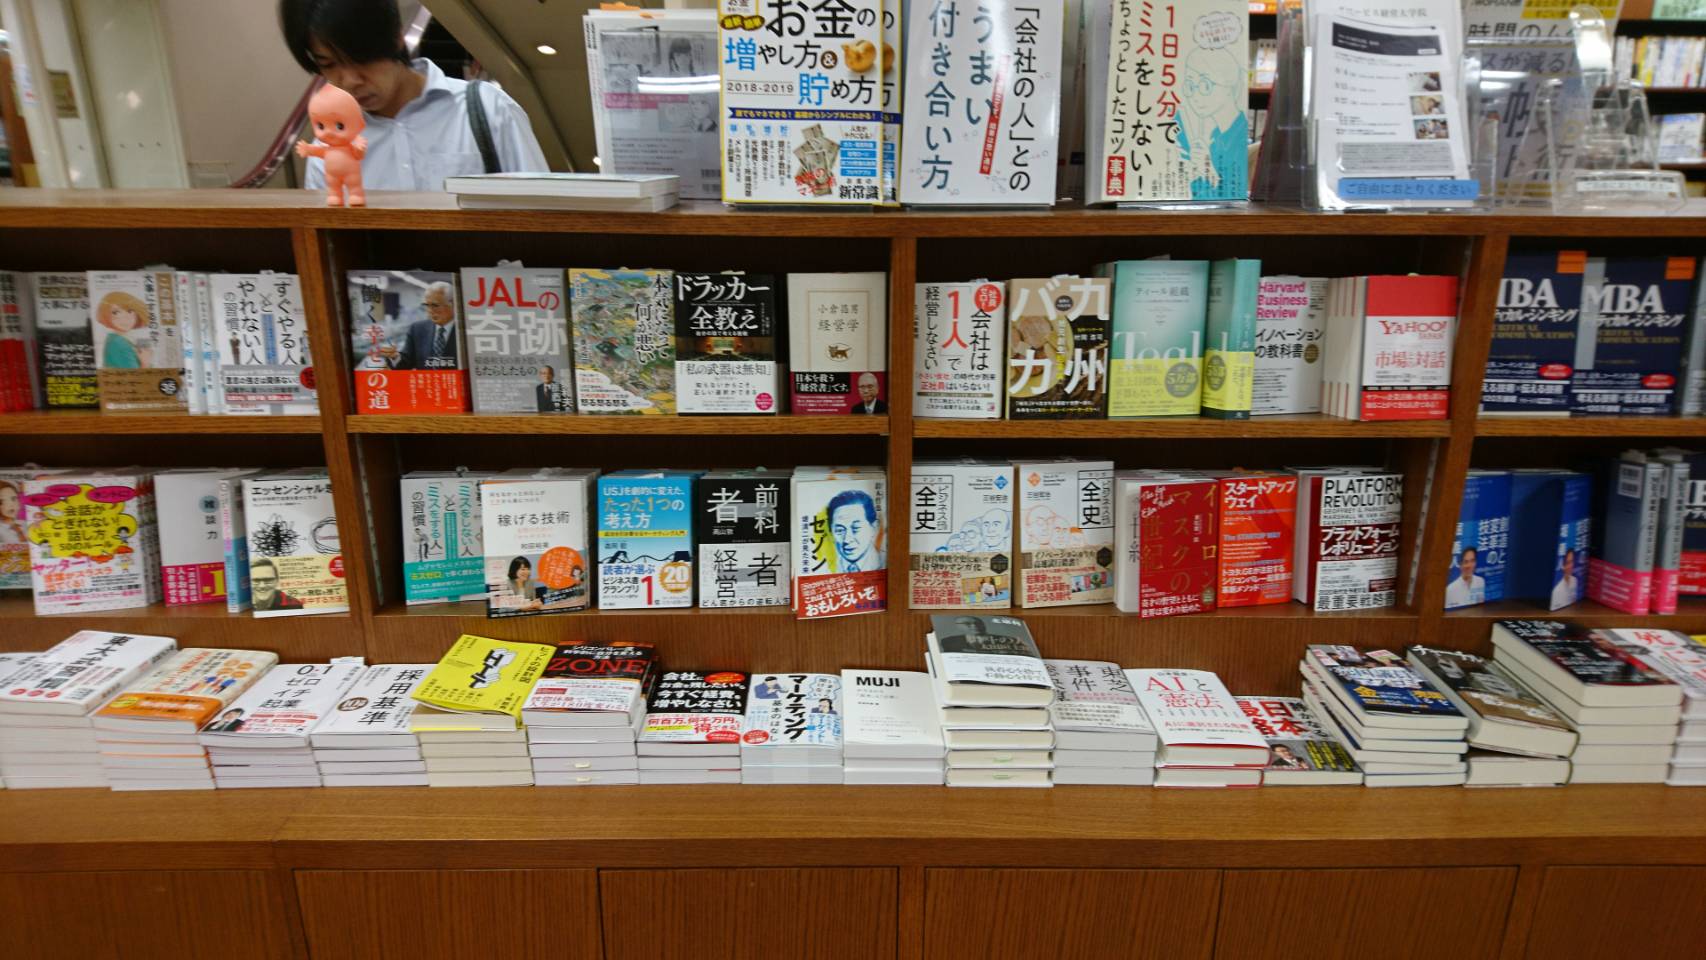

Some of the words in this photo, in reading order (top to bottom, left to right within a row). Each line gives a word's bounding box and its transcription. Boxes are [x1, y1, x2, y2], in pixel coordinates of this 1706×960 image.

[966, 5, 994, 125] うまい
[1157, 5, 1181, 145] 1日5分で
[727, 82, 794, 92] 2018-2019
[798, 73, 876, 106] 貯め方
[921, 0, 960, 191] 付き合い方
[1131, 1, 1157, 197] ミスをしない!
[468, 276, 560, 311] JALの
[676, 274, 771, 302] ドラッカー
[1258, 281, 1306, 294] Harvard
[1256, 294, 1308, 306] Business
[1583, 284, 1666, 314] MBA
[818, 304, 860, 314] 小倉昌男
[1255, 307, 1299, 319] Review
[689, 306, 760, 331] 全教え
[818, 318, 860, 332] 経営学
[466, 309, 567, 356] 奇跡
[635, 303, 656, 365] 何が悪い
[924, 286, 941, 370] 経営しなさい
[1254, 328, 1324, 343] イノベーション
[969, 309, 992, 371] 会社は
[1253, 344, 1304, 359] の教科書
[474, 366, 538, 376] もたらしたもの
[1223, 480, 1297, 496] スタートアップ
[65, 505, 105, 516] 会話が
[604, 497, 686, 512] たった1つの
[707, 487, 744, 524] 者
[753, 482, 780, 535] 前科
[914, 485, 937, 531] 全史
[1081, 480, 1101, 526] 全史
[1223, 494, 1258, 509] ウェイ
[497, 511, 571, 527] 稼げる技術
[604, 512, 652, 529] 考え方
[68, 530, 105, 541] 話し方
[809, 513, 827, 573] セゾン
[1169, 490, 1193, 594] マスクの
[1321, 526, 1400, 542] プラットフォーム
[603, 564, 655, 576] 読者が選ぶ
[714, 548, 739, 599] 経営
[747, 552, 782, 587] 者
[602, 576, 640, 585] ビジネス書
[602, 585, 640, 594] グランプリ
[547, 658, 649, 675] ZONE
[285, 678, 321, 687] ゼロ
[662, 672, 704, 681] 会社に
[856, 676, 901, 689] MUJI
[1066, 664, 1096, 692] 事件
[1144, 675, 1213, 693] AIと
[273, 688, 312, 698] イチ
[358, 669, 424, 725] 採用基準
[1157, 692, 1226, 710] 憲法
[260, 699, 302, 709] 起業
[652, 699, 742, 708] 増やしなさい
[783, 675, 808, 740] マーケティング
[769, 700, 783, 742] 基本のはなし
[1258, 700, 1310, 737] 日本
